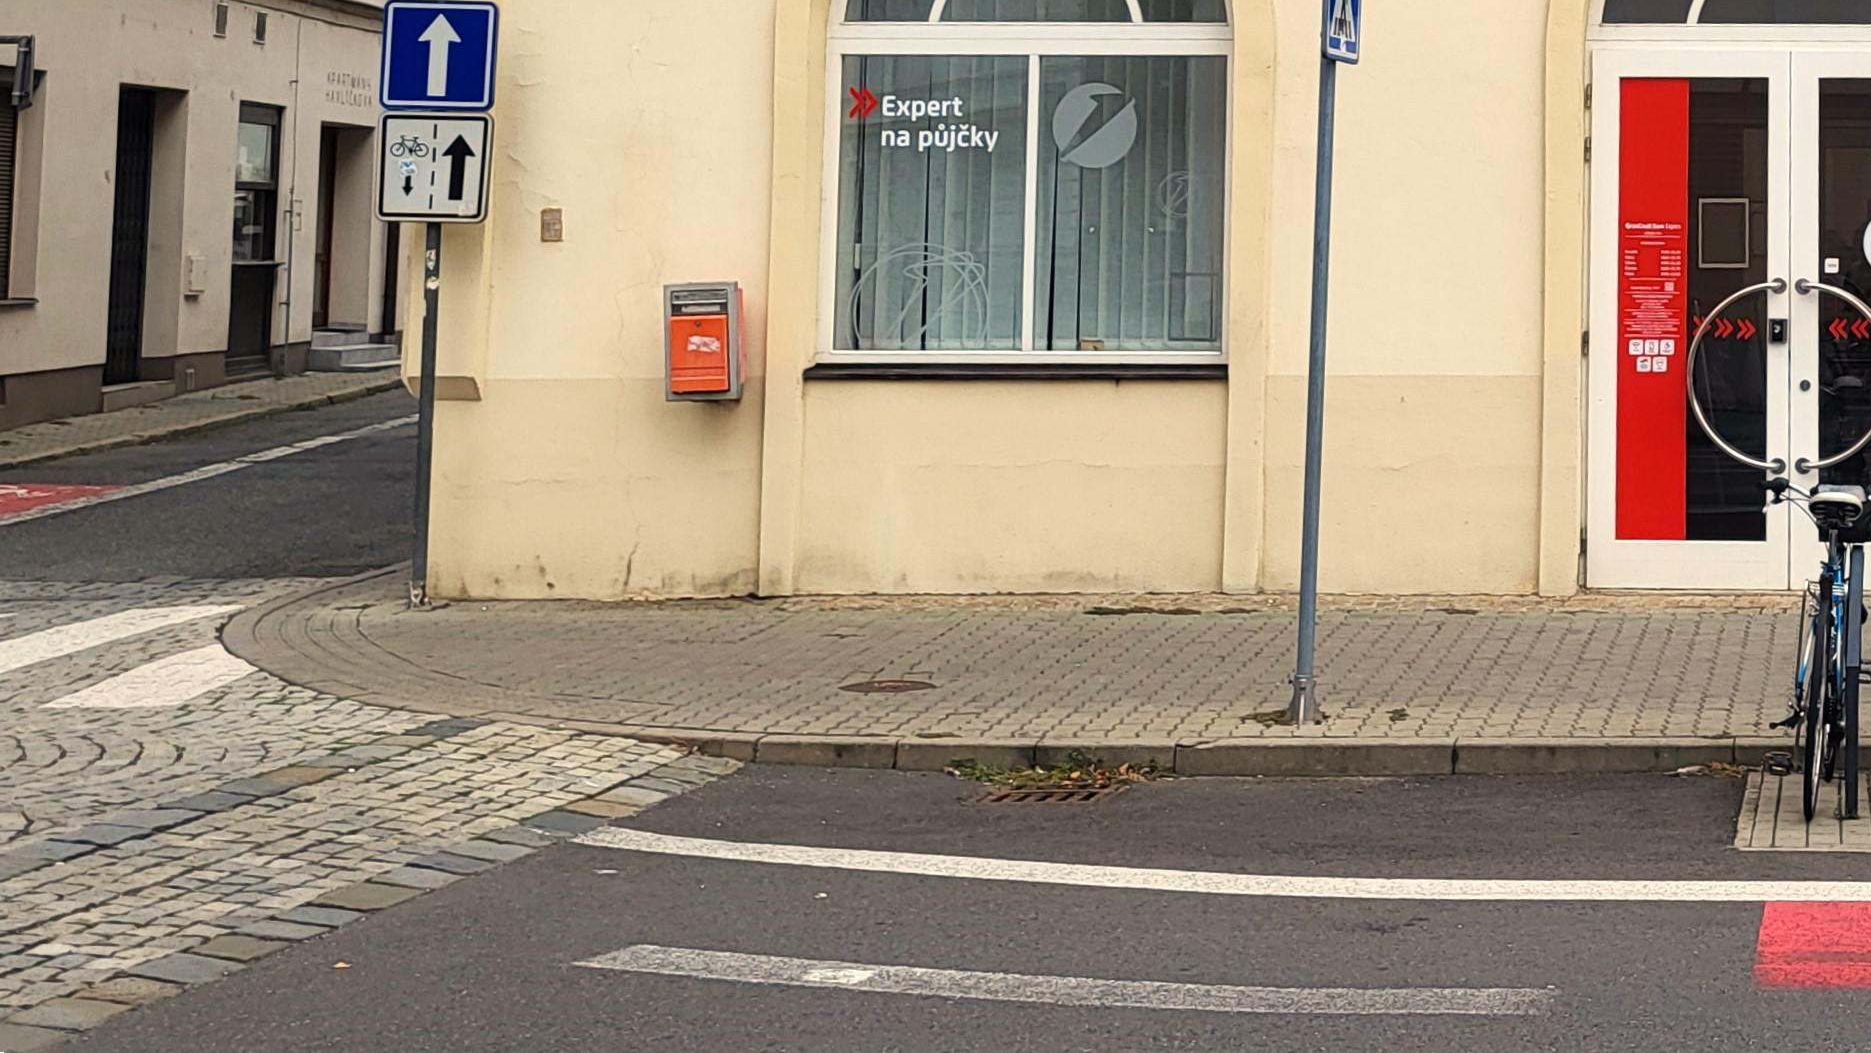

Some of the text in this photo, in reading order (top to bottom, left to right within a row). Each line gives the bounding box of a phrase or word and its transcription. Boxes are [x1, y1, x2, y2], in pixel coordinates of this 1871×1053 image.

[882, 96, 963, 121] Expert
[881, 124, 999, 152] na půjčky
